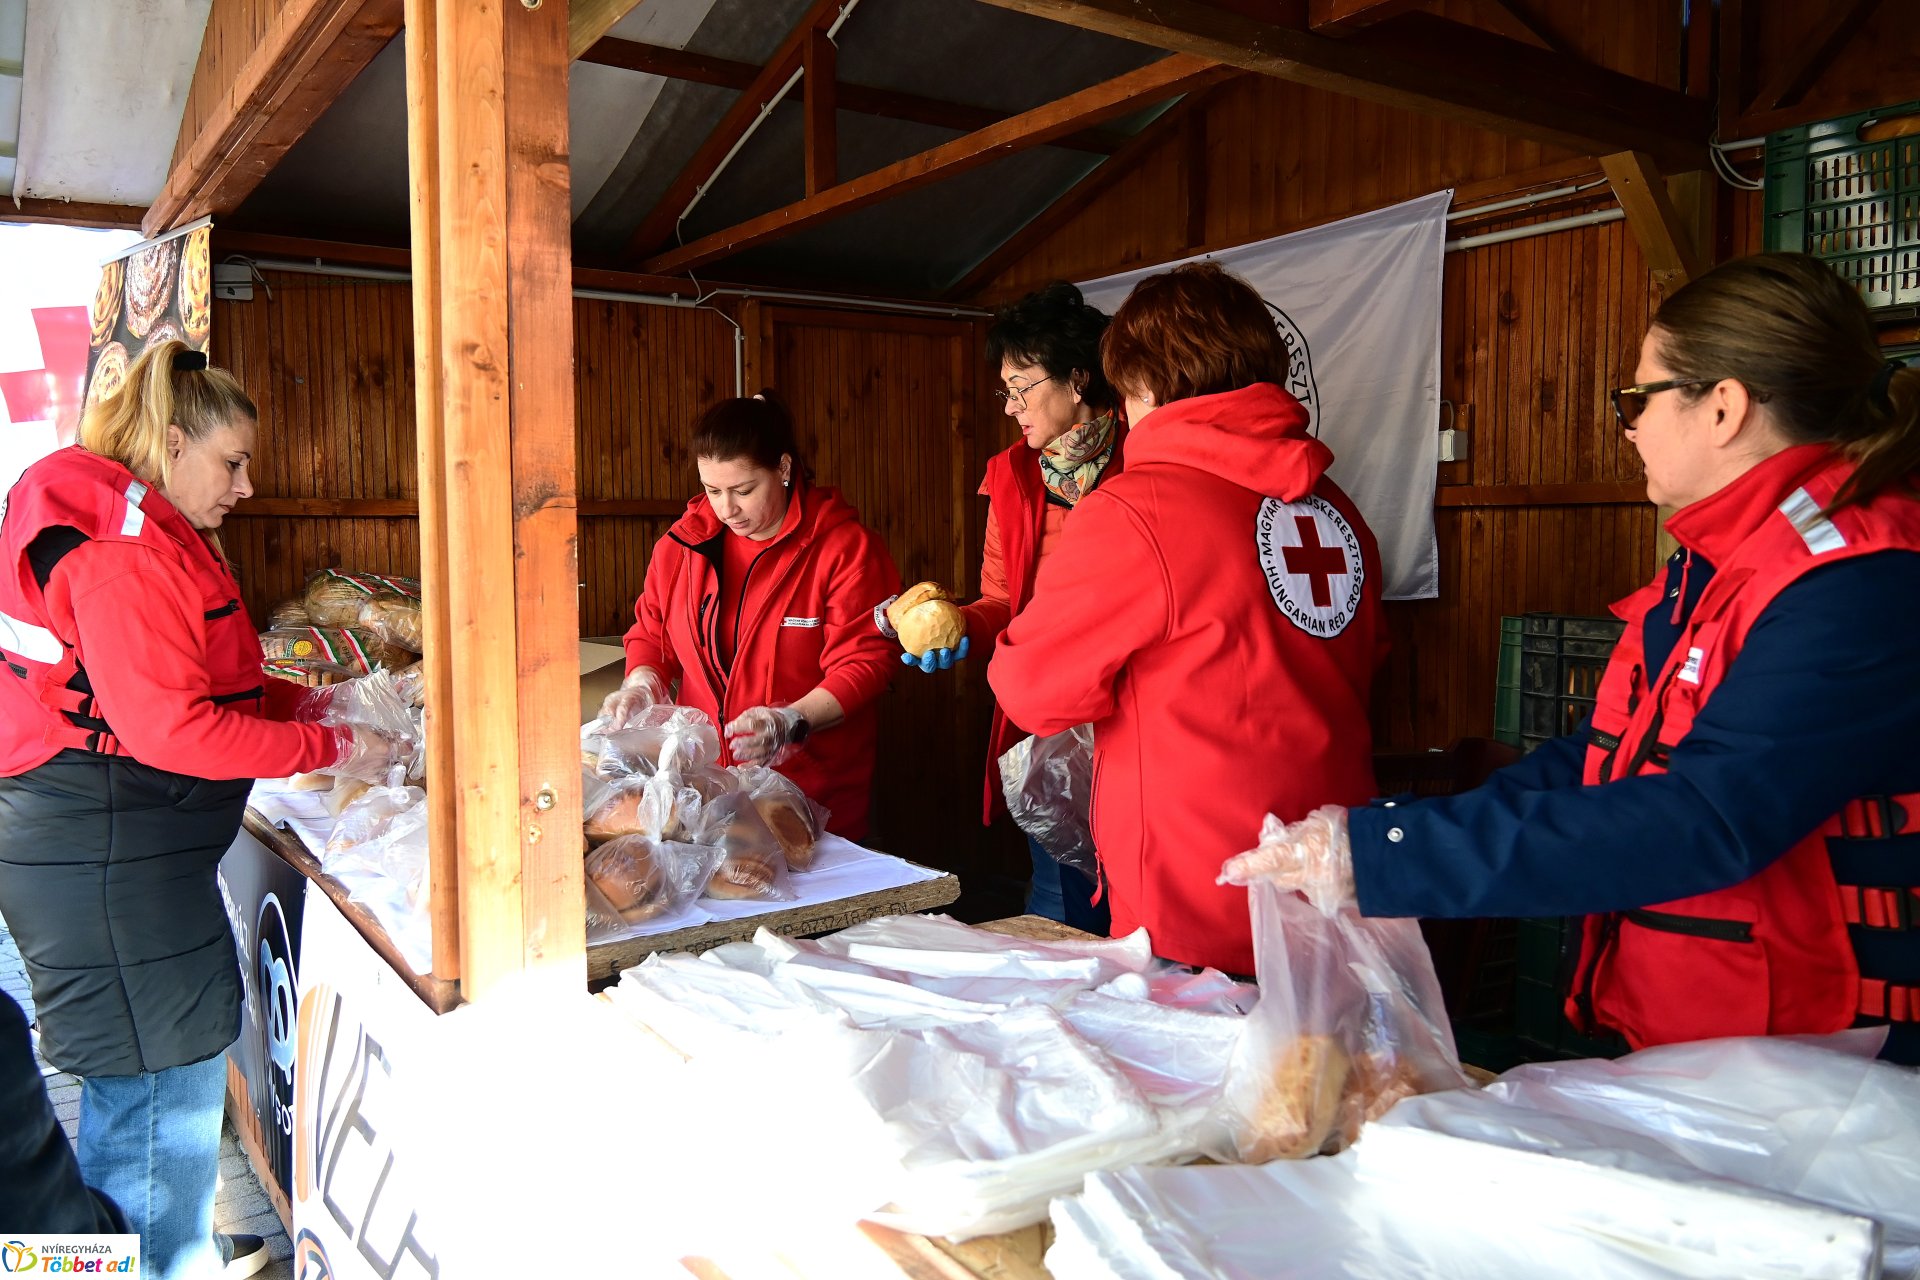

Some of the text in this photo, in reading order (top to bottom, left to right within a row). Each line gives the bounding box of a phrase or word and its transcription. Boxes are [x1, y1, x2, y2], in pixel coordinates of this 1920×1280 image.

[1275, 320, 1312, 405] RESZT
[1261, 499, 1281, 556] MAGYAR
[1266, 566, 1362, 633] HUNGARIAN RED CROSS
